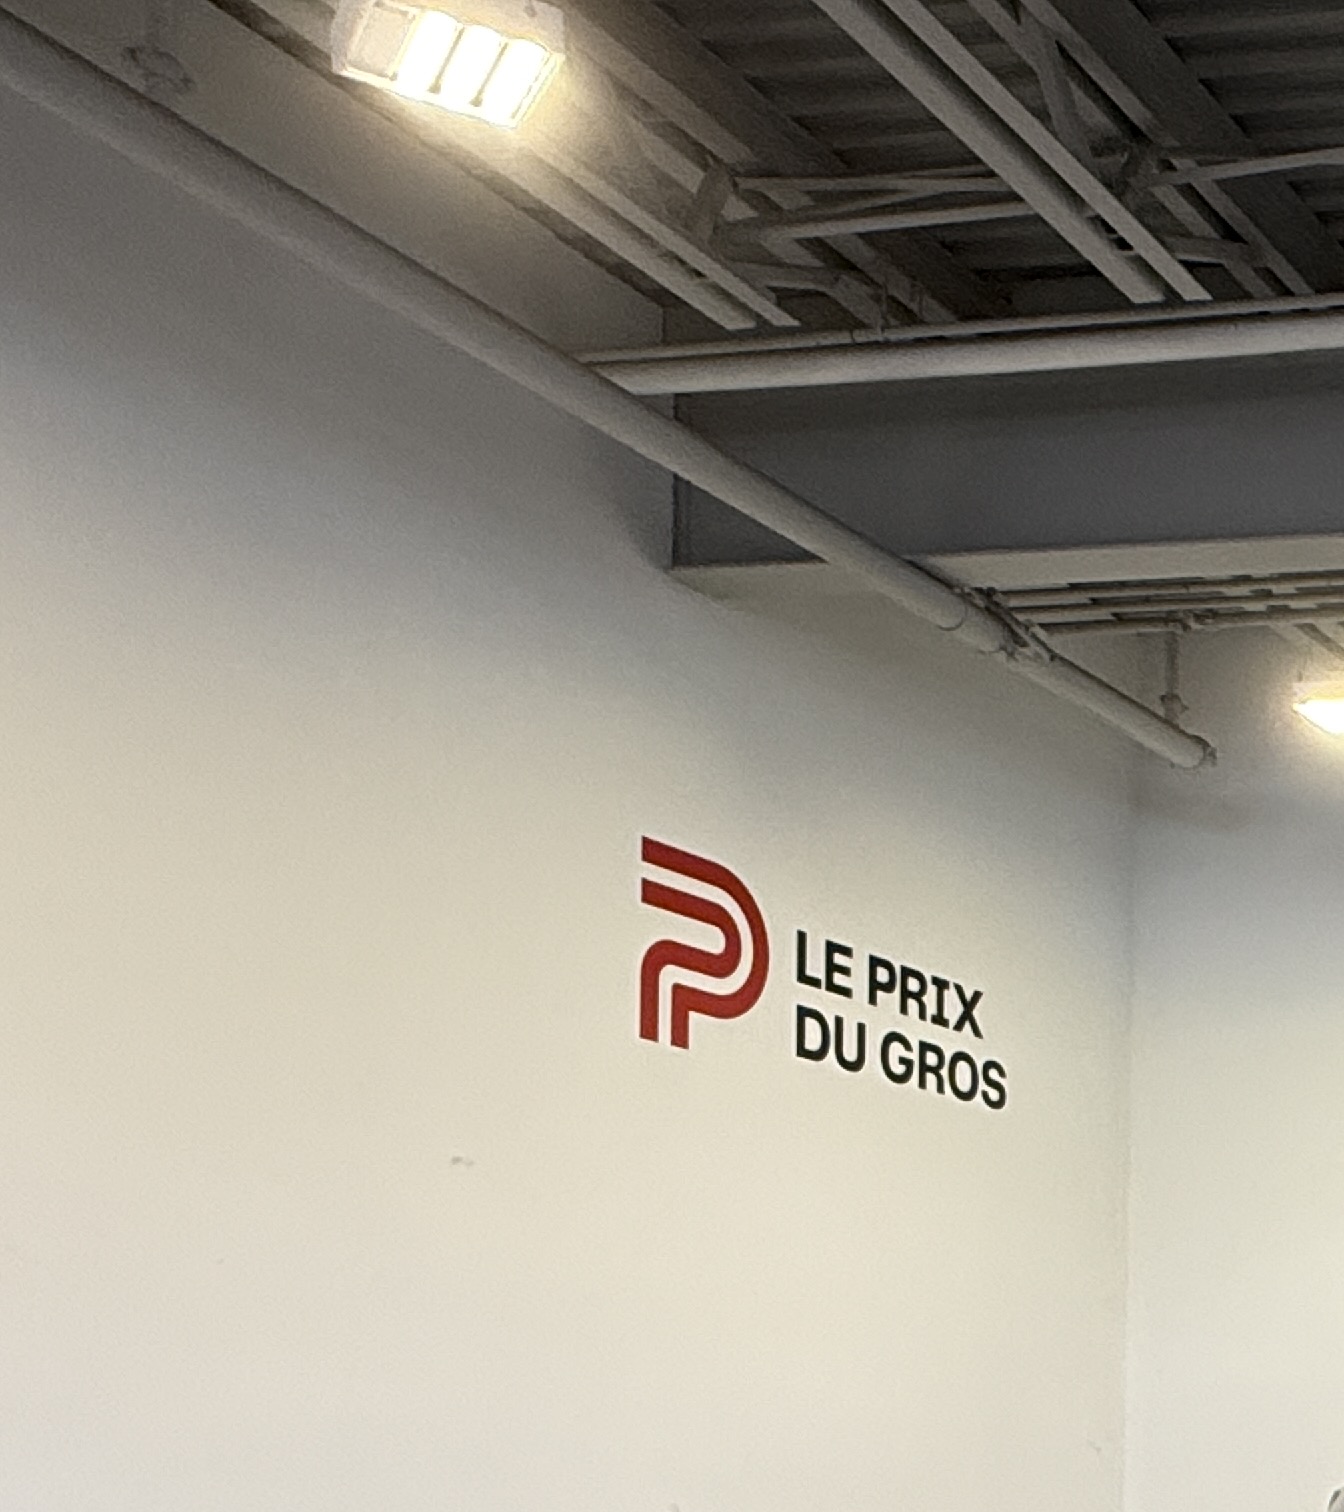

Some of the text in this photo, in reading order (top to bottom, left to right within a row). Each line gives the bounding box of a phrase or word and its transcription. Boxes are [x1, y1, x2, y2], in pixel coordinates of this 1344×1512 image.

[796, 929, 984, 1039] LE PRIX
[796, 1004, 1007, 1111] DU GROS
